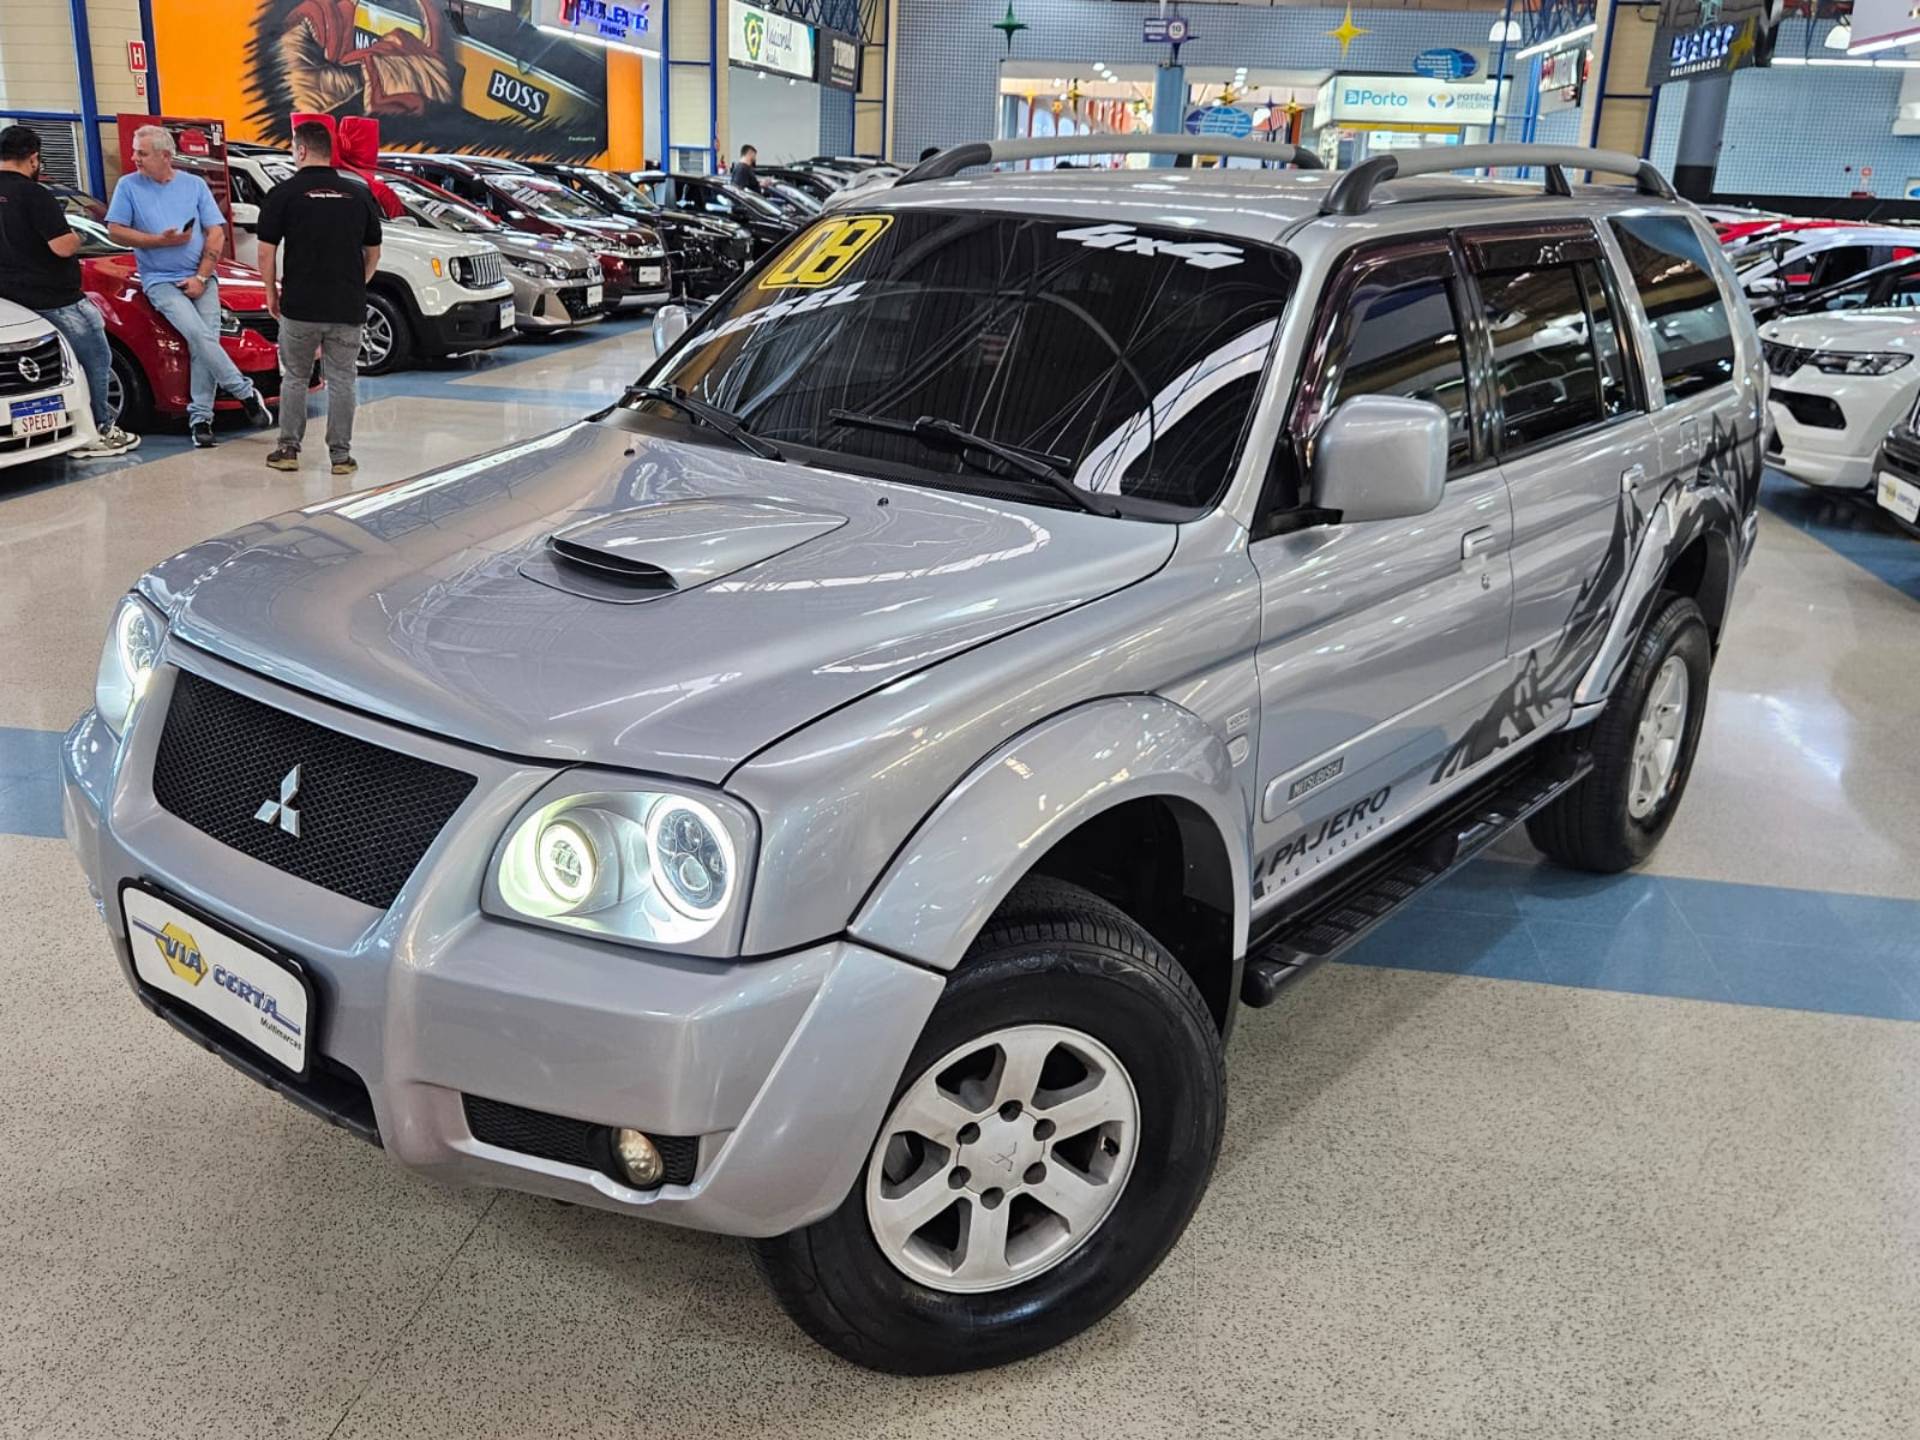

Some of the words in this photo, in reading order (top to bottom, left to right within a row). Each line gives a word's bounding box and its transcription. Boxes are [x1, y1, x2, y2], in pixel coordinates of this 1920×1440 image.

[132, 46, 143, 66] H
[490, 73, 545, 114] BOSS
[1361, 89, 1408, 106] Porto
[22, 412, 59, 433] SPEEDY
[1268, 785, 1392, 876] PAJERO
[164, 936, 202, 976] VIA
[212, 963, 279, 1017] CERTA
[260, 1016, 302, 1051] Multimarcas
